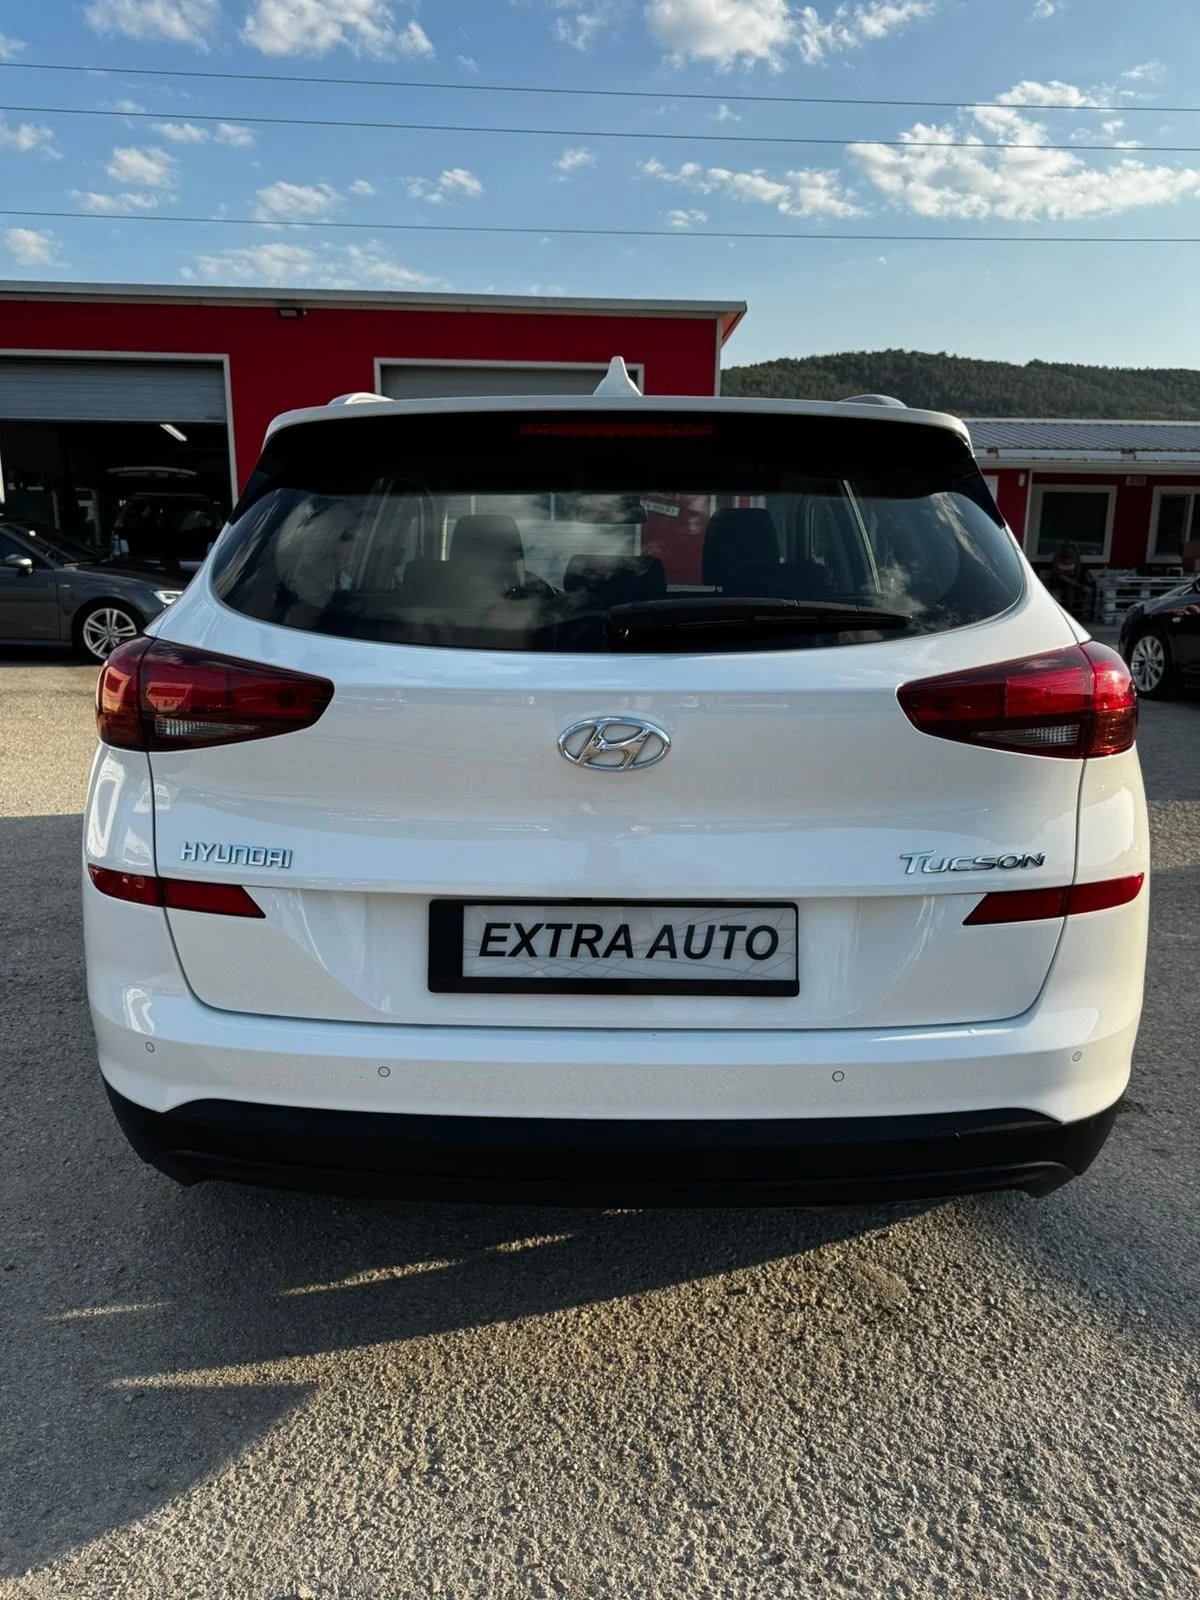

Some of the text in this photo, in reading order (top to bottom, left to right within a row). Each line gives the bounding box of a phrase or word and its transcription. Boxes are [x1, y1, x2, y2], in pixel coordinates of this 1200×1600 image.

[180, 841, 293, 869] HYUNDAI
[899, 850, 1045, 874] TUCSON
[478, 922, 779, 961] EXTRA AUTO
